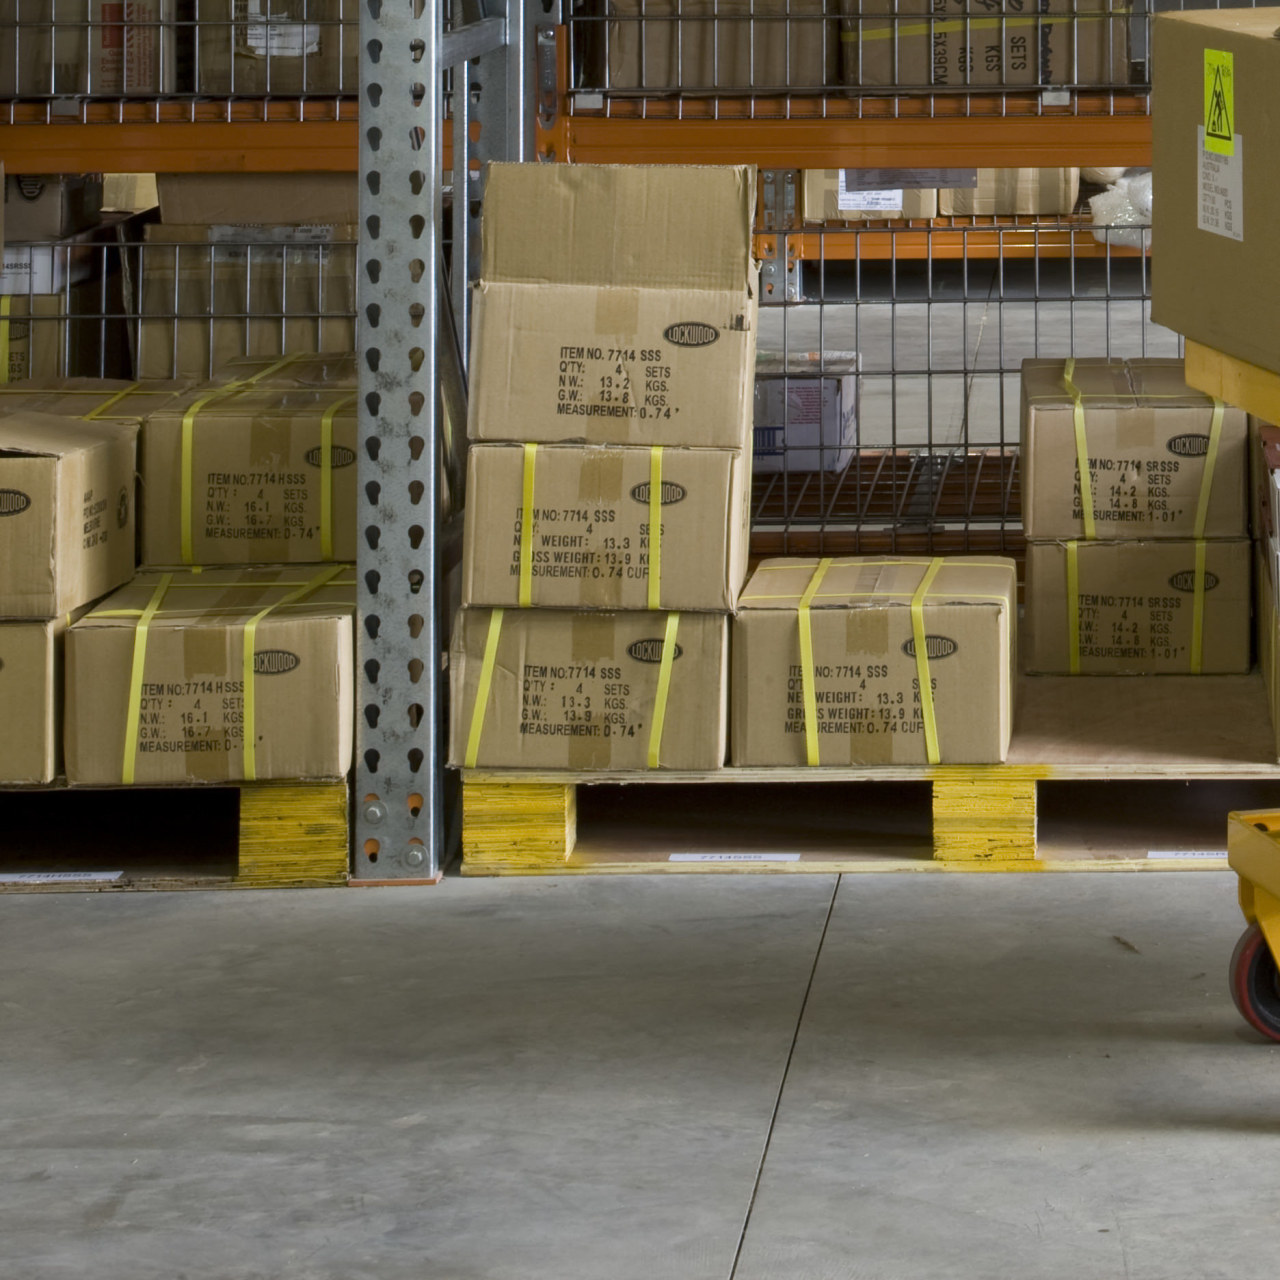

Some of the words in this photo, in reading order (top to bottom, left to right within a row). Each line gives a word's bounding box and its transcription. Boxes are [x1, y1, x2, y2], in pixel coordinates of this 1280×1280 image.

[669, 326, 715, 344] LOCKWOOD
[560, 347, 584, 359] ITEM
[587, 348, 604, 360] NO.
[608, 350, 635, 361] 7714
[640, 350, 661, 361] SSS
[616, 365, 622, 375] 4
[646, 366, 670, 378] SETS
[646, 381, 669, 392] KGS.
[557, 404, 637, 418] MEASUREMENT:
[568, 667, 596, 678] 7714
[601, 668, 621, 679] SSS
